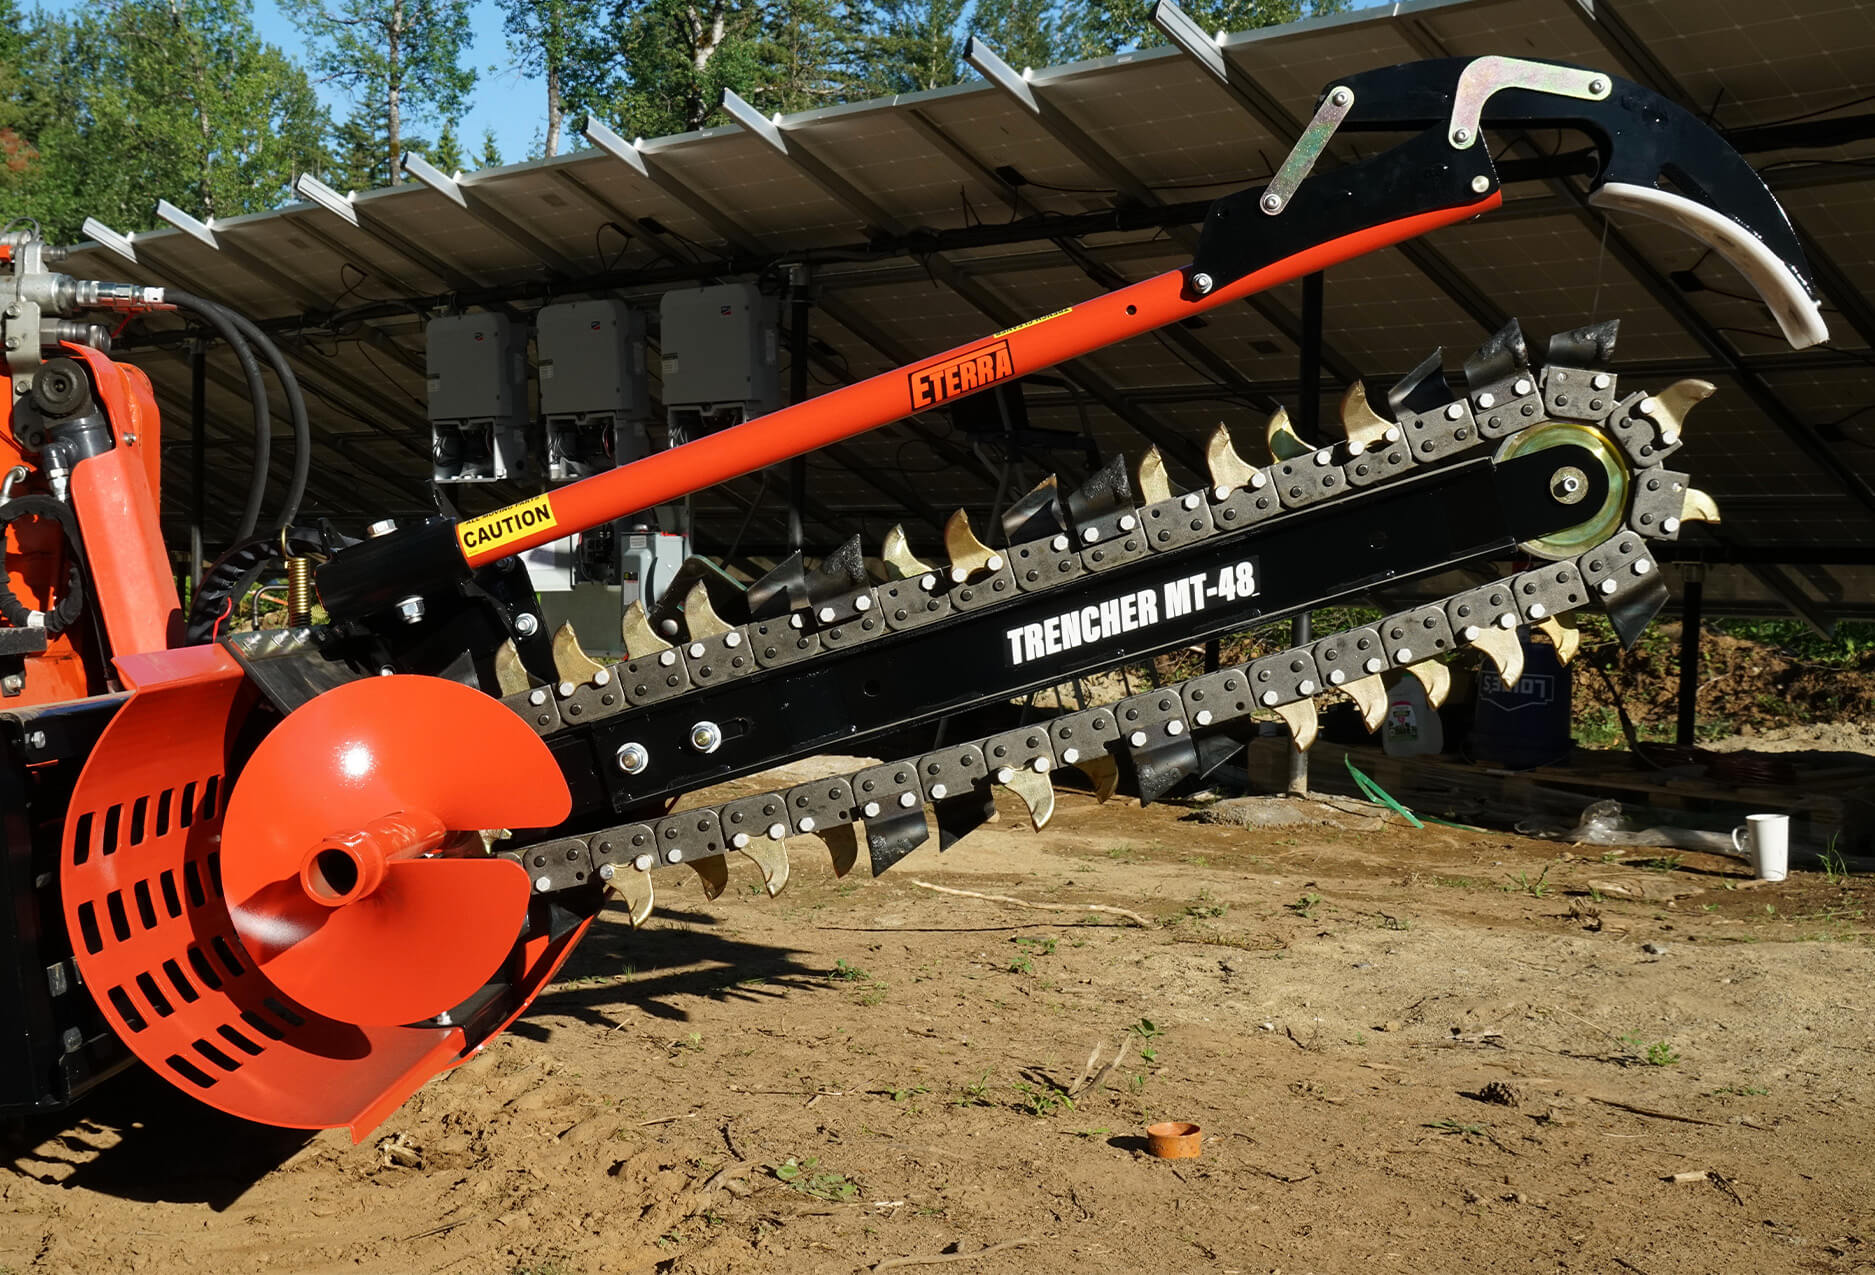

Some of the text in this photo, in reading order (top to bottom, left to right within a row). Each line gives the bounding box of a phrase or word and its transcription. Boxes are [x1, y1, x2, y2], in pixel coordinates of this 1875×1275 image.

[910, 340, 1013, 409] ETERRA
[463, 503, 550, 548] CAUTION
[1007, 561, 1256, 666] TRENCHER MT-48
